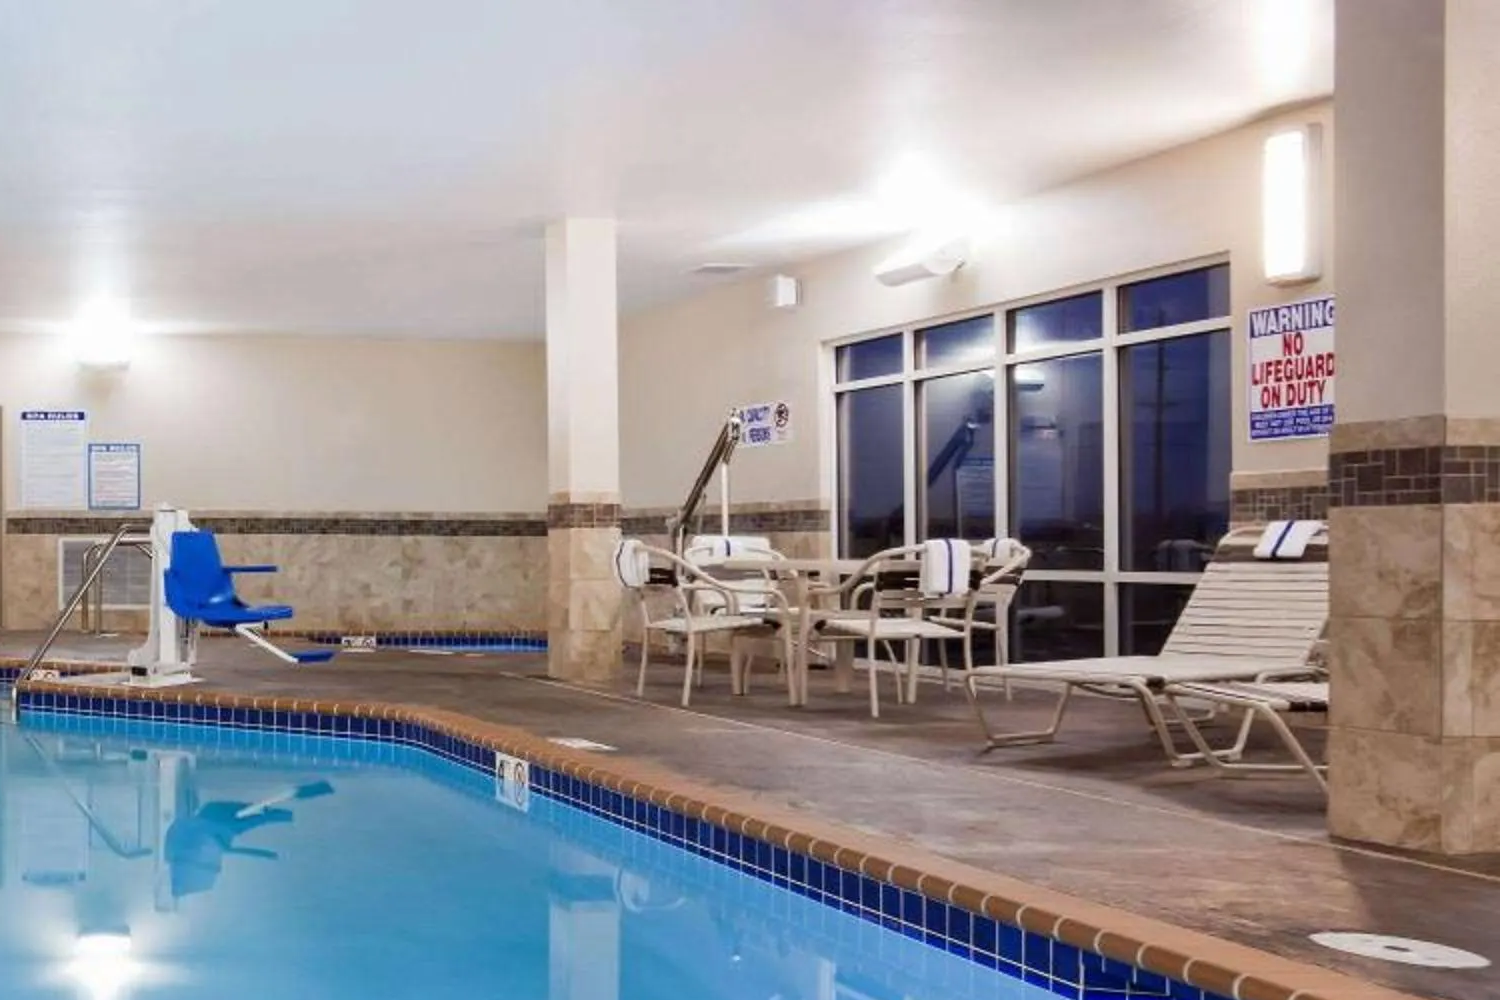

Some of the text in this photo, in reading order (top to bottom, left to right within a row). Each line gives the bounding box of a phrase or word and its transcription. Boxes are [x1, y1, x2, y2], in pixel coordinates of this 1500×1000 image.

[1251, 300, 1335, 337] WARNING
[1282, 331, 1304, 357] NO
[1251, 352, 1335, 385] LIFEGUARD
[1261, 379, 1326, 408] ON DUTY
